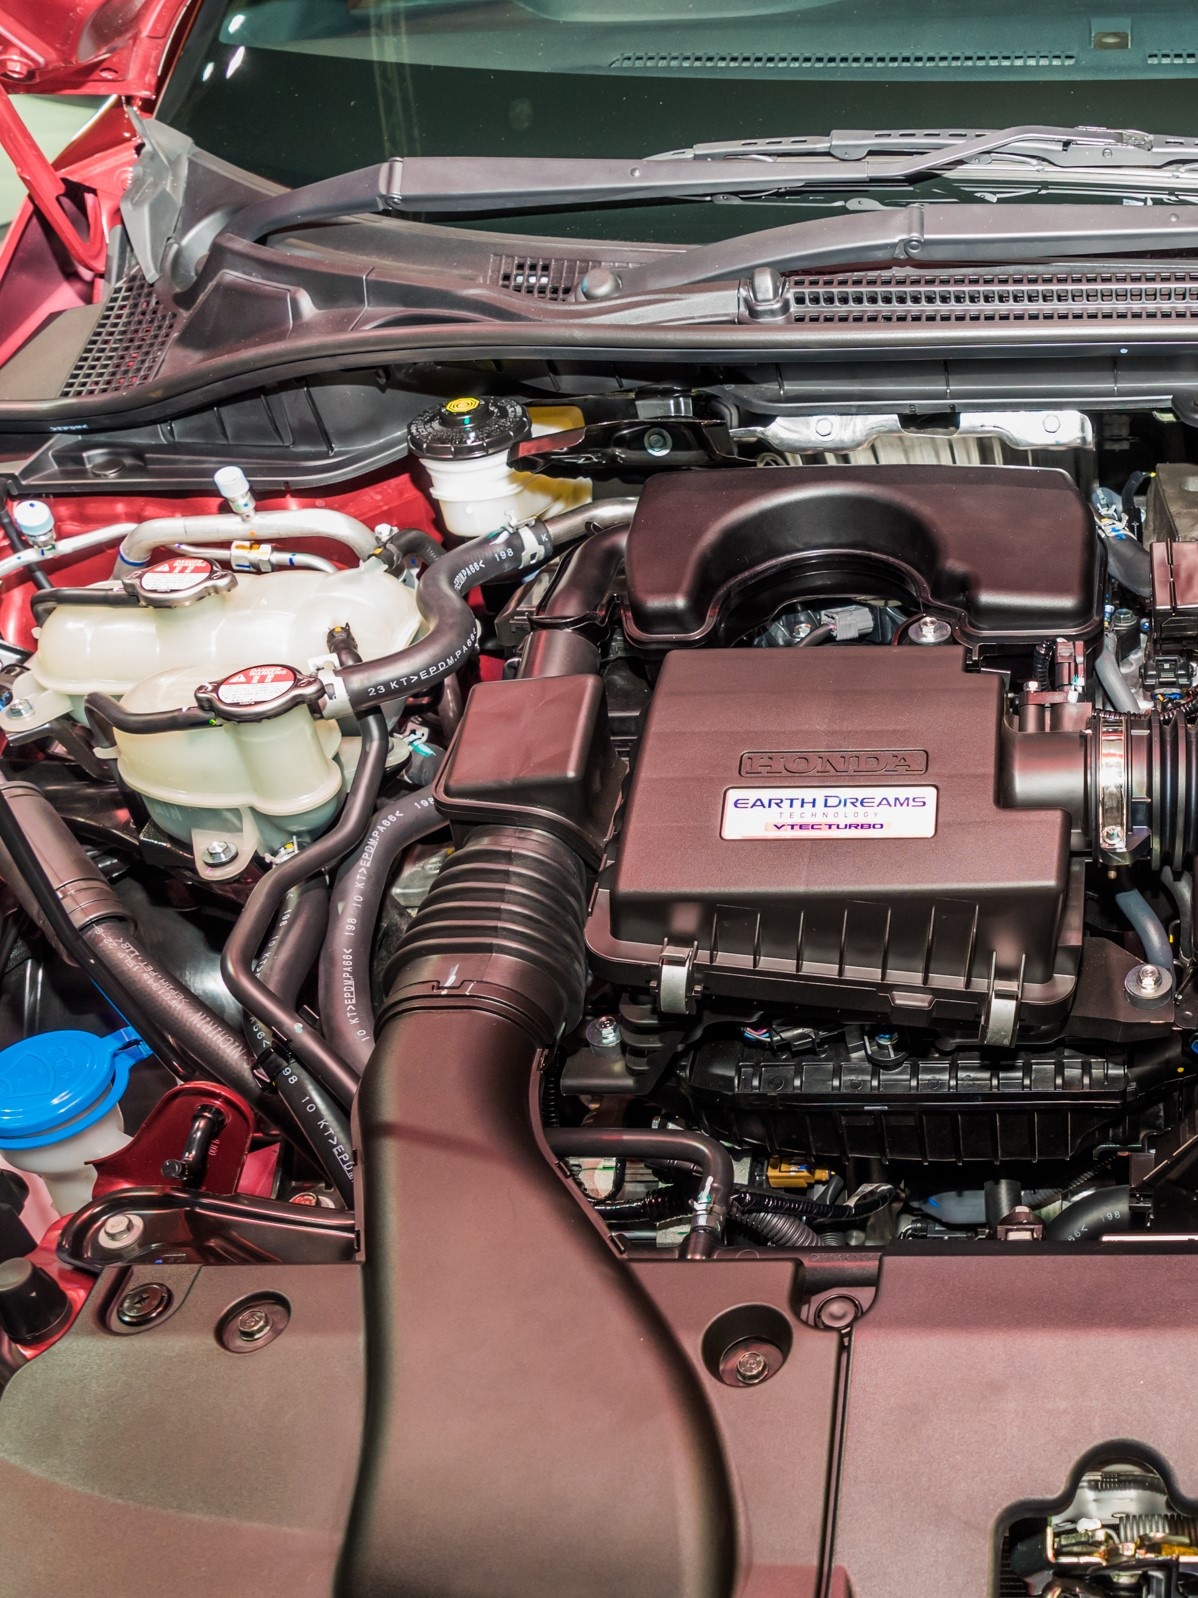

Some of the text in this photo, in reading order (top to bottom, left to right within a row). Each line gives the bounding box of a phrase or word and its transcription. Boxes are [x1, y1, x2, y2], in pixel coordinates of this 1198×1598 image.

[494, 547, 514, 562] 198
[367, 685, 386, 697] 23
[745, 754, 926, 775] HONDA
[733, 795, 927, 809] EARTH DREAMS
[779, 811, 879, 819] TECHNOLOGY
[344, 917, 357, 936] 198
[282, 1067, 298, 1084] 98
[301, 1096, 316, 1112] 10
